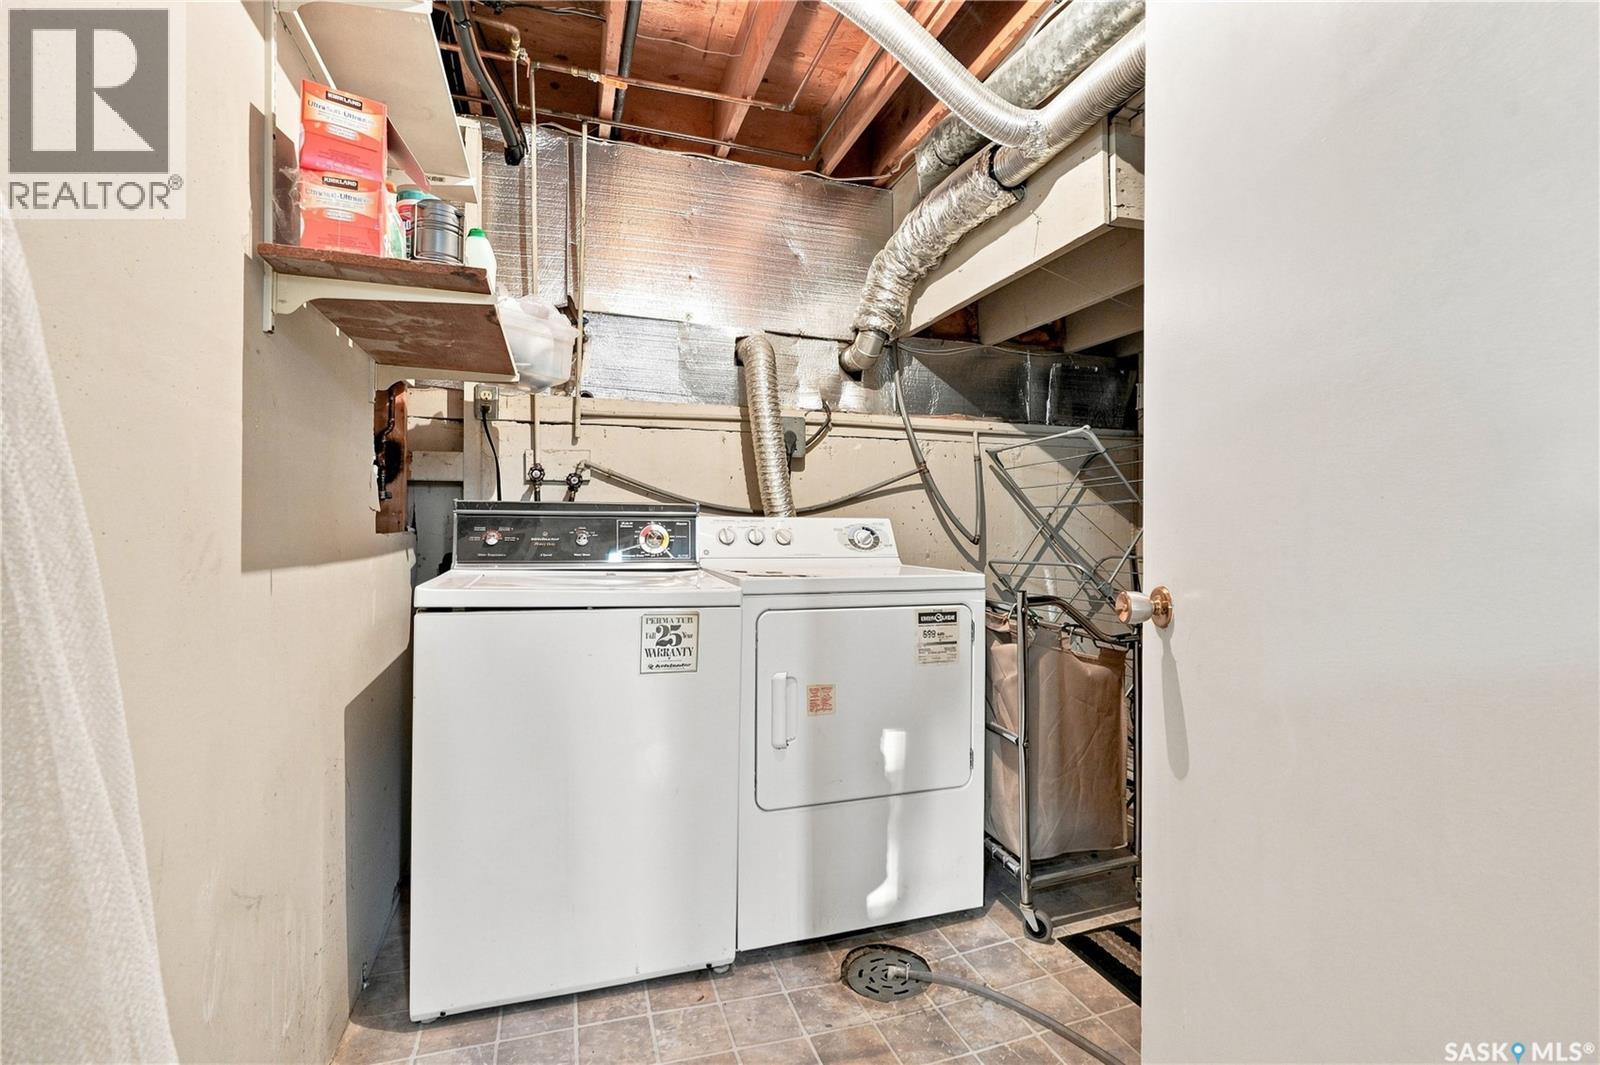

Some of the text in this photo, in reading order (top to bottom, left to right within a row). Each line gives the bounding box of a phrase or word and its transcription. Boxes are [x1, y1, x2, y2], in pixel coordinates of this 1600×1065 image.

[327, 92, 362, 106] KIRKLAND
[323, 176, 357, 188] KIRKLAND
[655, 624, 683, 647] 25
[644, 647, 695, 658] WARRANTY
